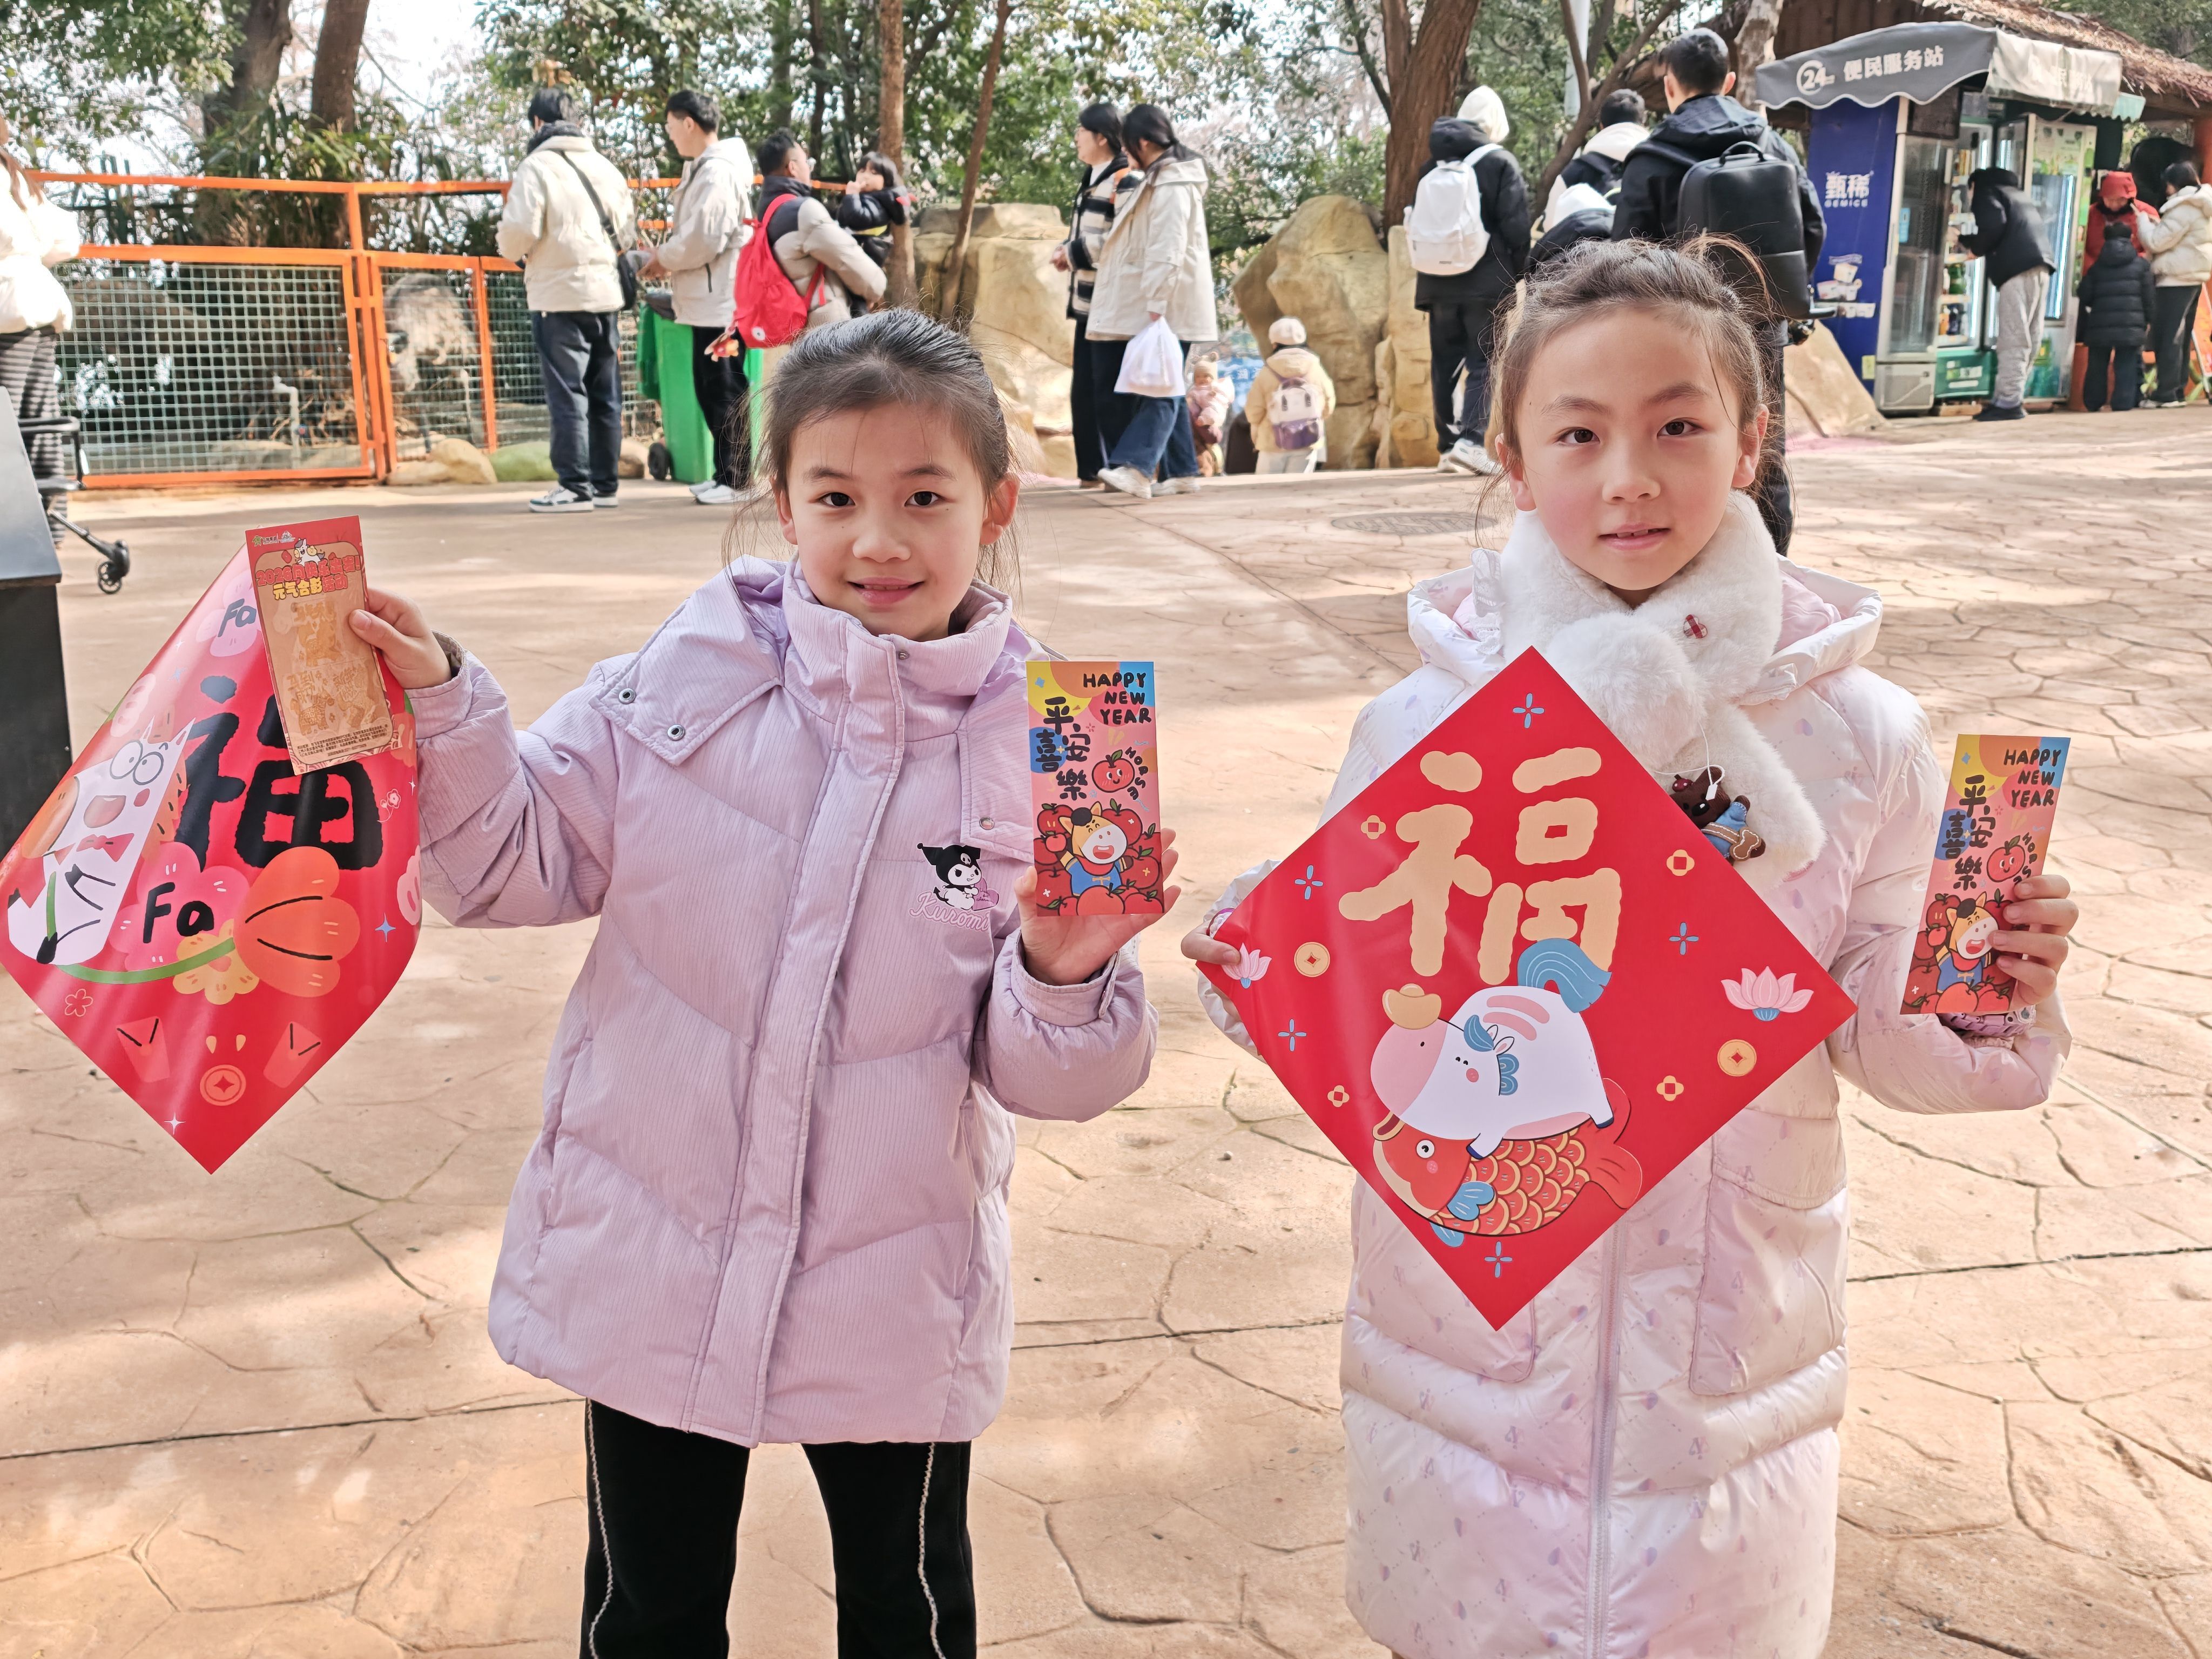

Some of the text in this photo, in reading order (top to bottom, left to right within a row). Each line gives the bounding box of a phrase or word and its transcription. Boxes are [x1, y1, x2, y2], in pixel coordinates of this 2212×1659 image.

[1844, 45, 1944, 82] 便民服务站
[1083, 672, 1147, 688] HAPPY
[1104, 691, 1145, 705] NEW
[1100, 707, 1152, 725] YEAR
[2004, 748, 2061, 767] HAPPY
[176, 675, 383, 871] 福
[1125, 747, 1149, 800] HORSE
[2018, 769, 2055, 785] NEW
[2011, 789, 2054, 807] YEAR
[1339, 747, 1621, 984] 福
[909, 890, 989, 932] Kuromi
